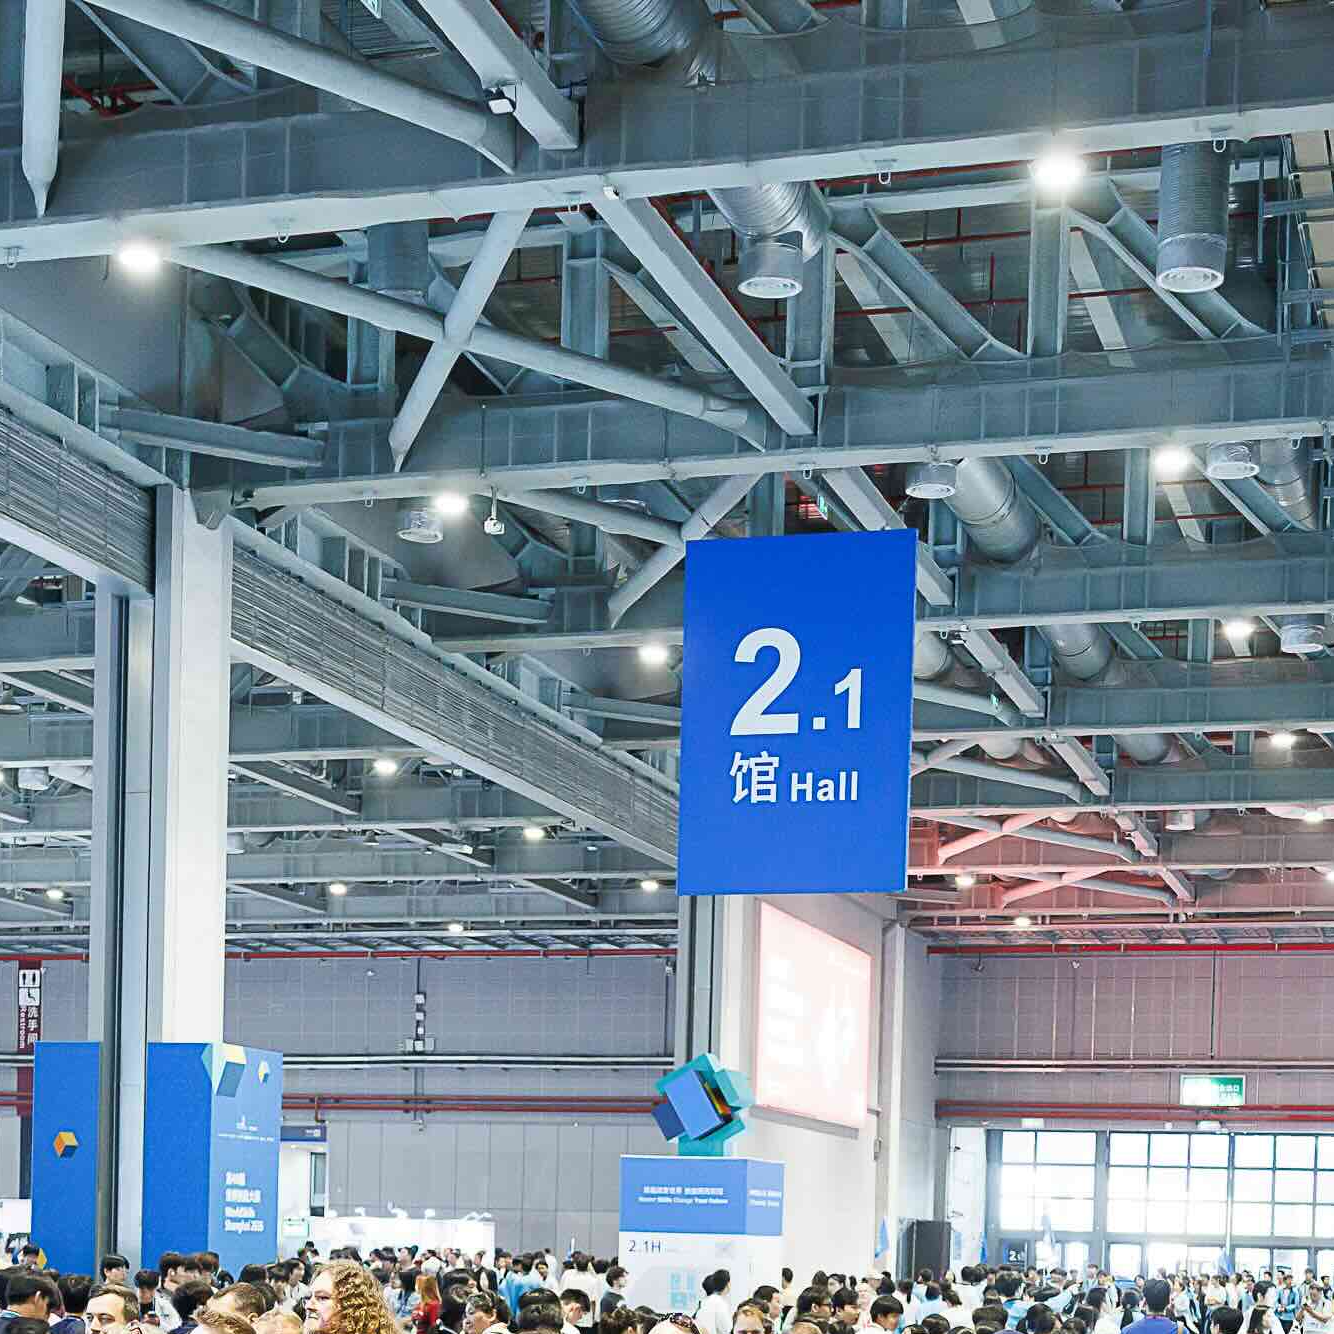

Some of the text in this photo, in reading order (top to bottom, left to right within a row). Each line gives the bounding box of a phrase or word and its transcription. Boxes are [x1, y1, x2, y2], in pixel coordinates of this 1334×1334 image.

[730, 627, 862, 736] 2.1
[729, 751, 859, 804] 馆 Hall
